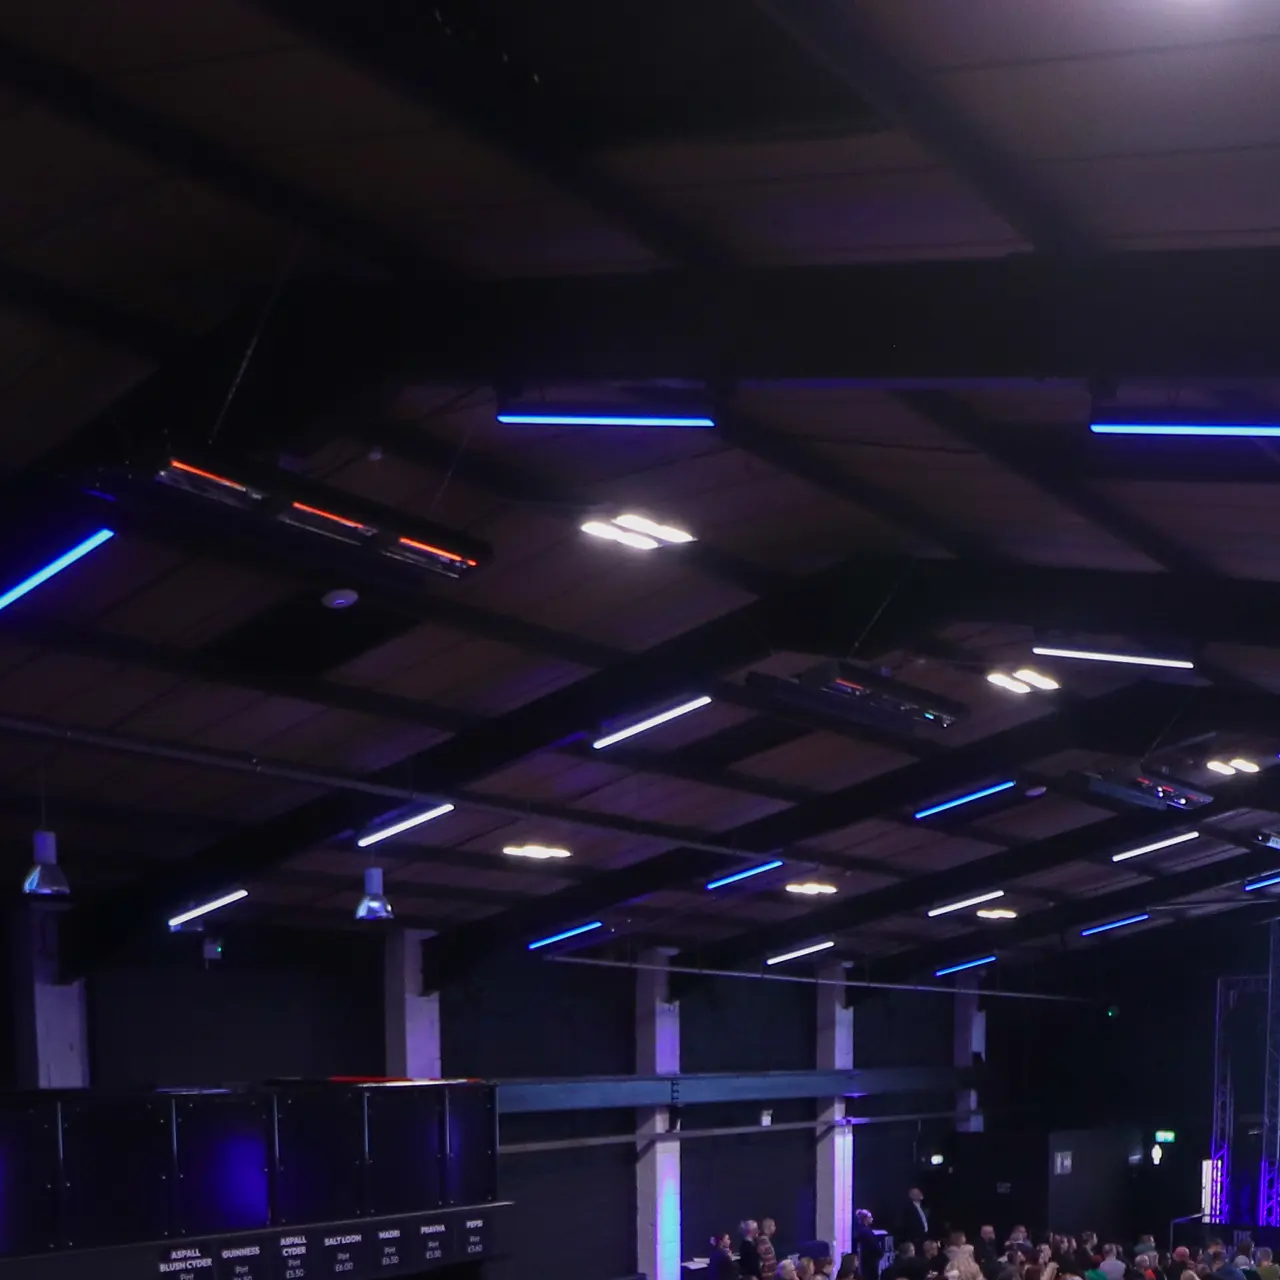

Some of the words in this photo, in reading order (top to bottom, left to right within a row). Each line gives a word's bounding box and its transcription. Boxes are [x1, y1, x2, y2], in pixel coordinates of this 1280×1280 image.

[280, 1236, 307, 1246] ASPALL
[324, 1236, 341, 1246] SALT
[170, 1248, 202, 1260] ASPALL
[221, 1246, 260, 1259] GUINNESS
[282, 1246, 307, 1256] CYDER
[159, 1260, 186, 1272] BLUSH
[186, 1258, 213, 1269] CYDER
[286, 1269, 305, 1279] £5.50
